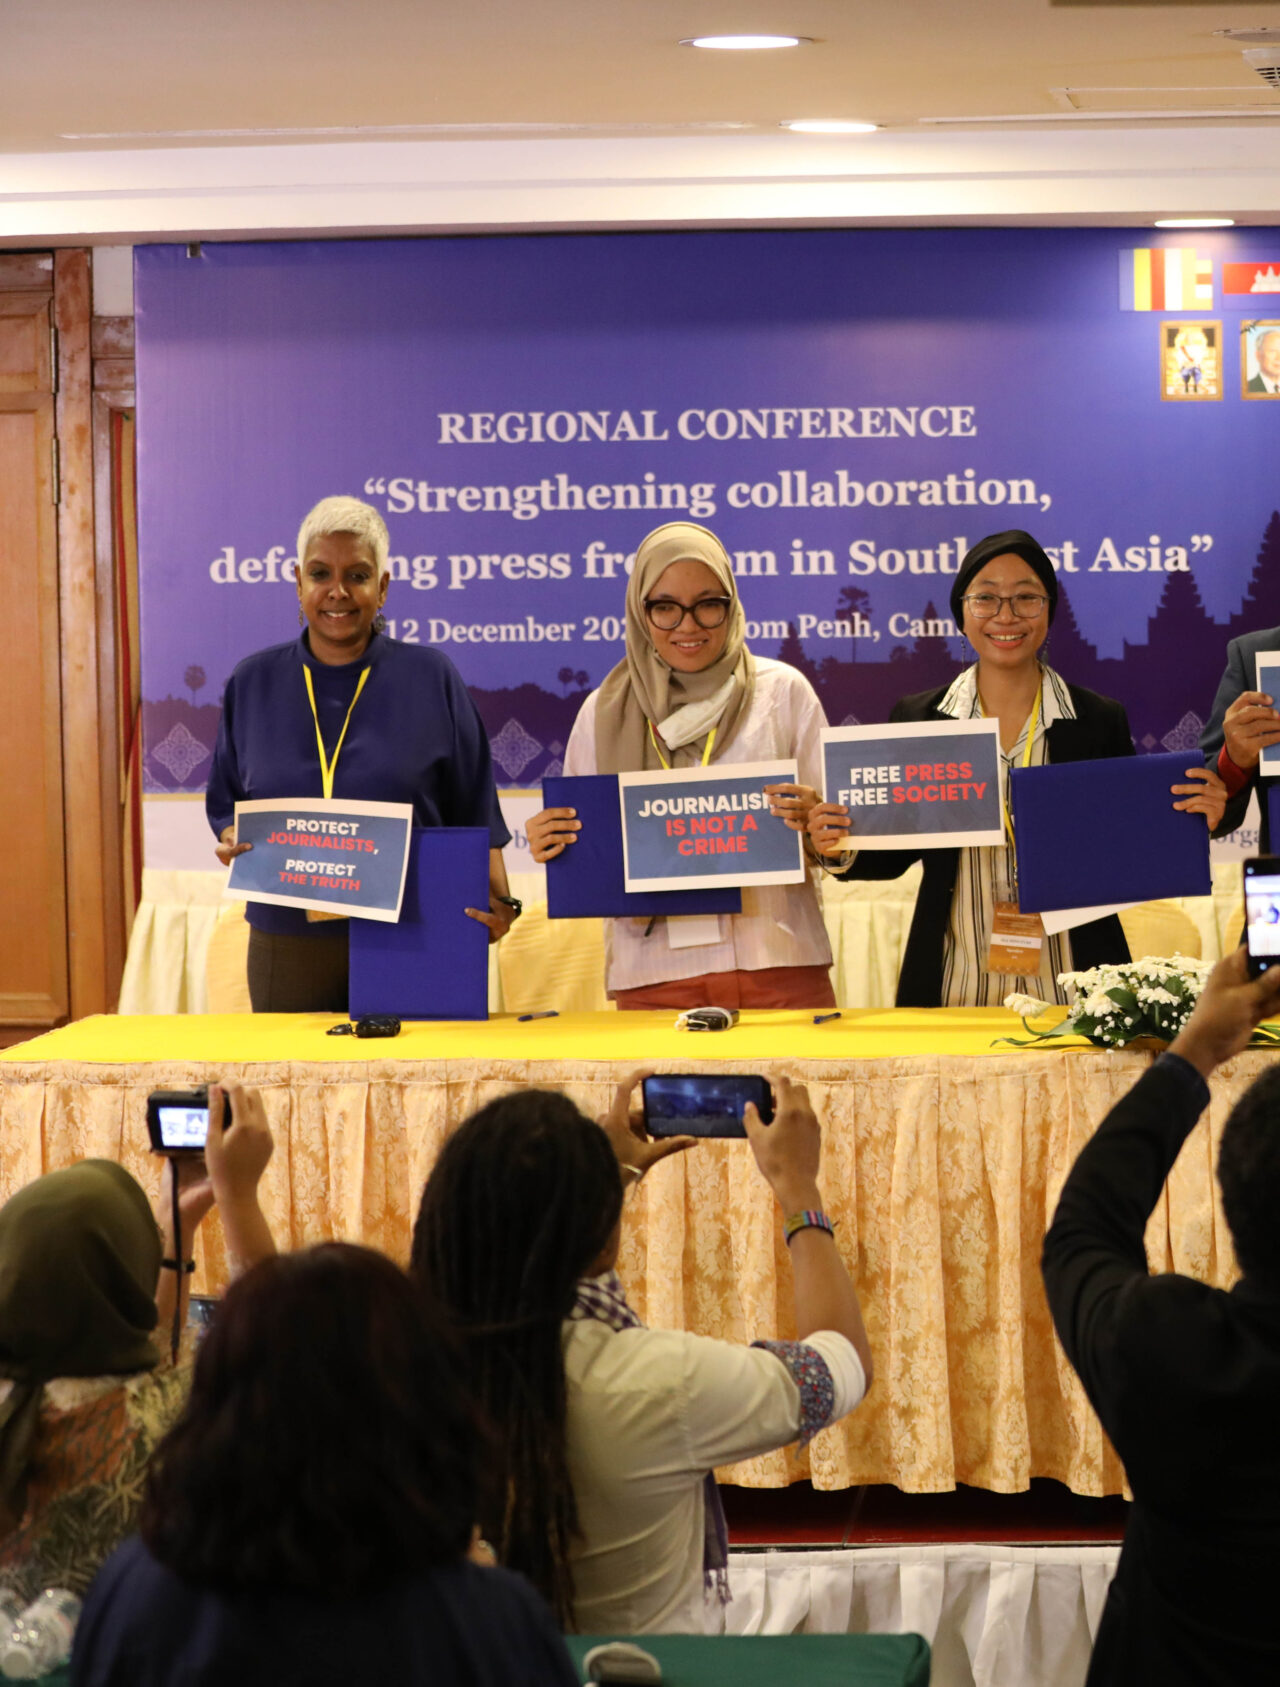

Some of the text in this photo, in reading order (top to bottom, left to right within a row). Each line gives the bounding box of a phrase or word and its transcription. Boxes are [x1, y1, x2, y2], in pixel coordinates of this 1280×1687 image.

[437, 406, 977, 445] REGIONAL CONFERENCE
[364, 469, 1052, 520] “Strengthening collaboration,
[208, 546, 438, 592] defeng
[447, 551, 572, 590] press
[790, 539, 838, 576] in
[1088, 534, 1214, 574] Asia”
[428, 614, 576, 644] December
[798, 611, 880, 641] Penh,
[850, 762, 973, 786] FREE PRESS
[838, 782, 987, 807] FREE SOCIETY
[286, 818, 359, 835] PROTECT
[666, 814, 758, 837] IS NOT A
[266, 831, 380, 855] JOURNALISTS,
[678, 836, 748, 856] CRIME
[285, 859, 356, 877] PROTECT
[279, 871, 361, 892] THE TRUTH
